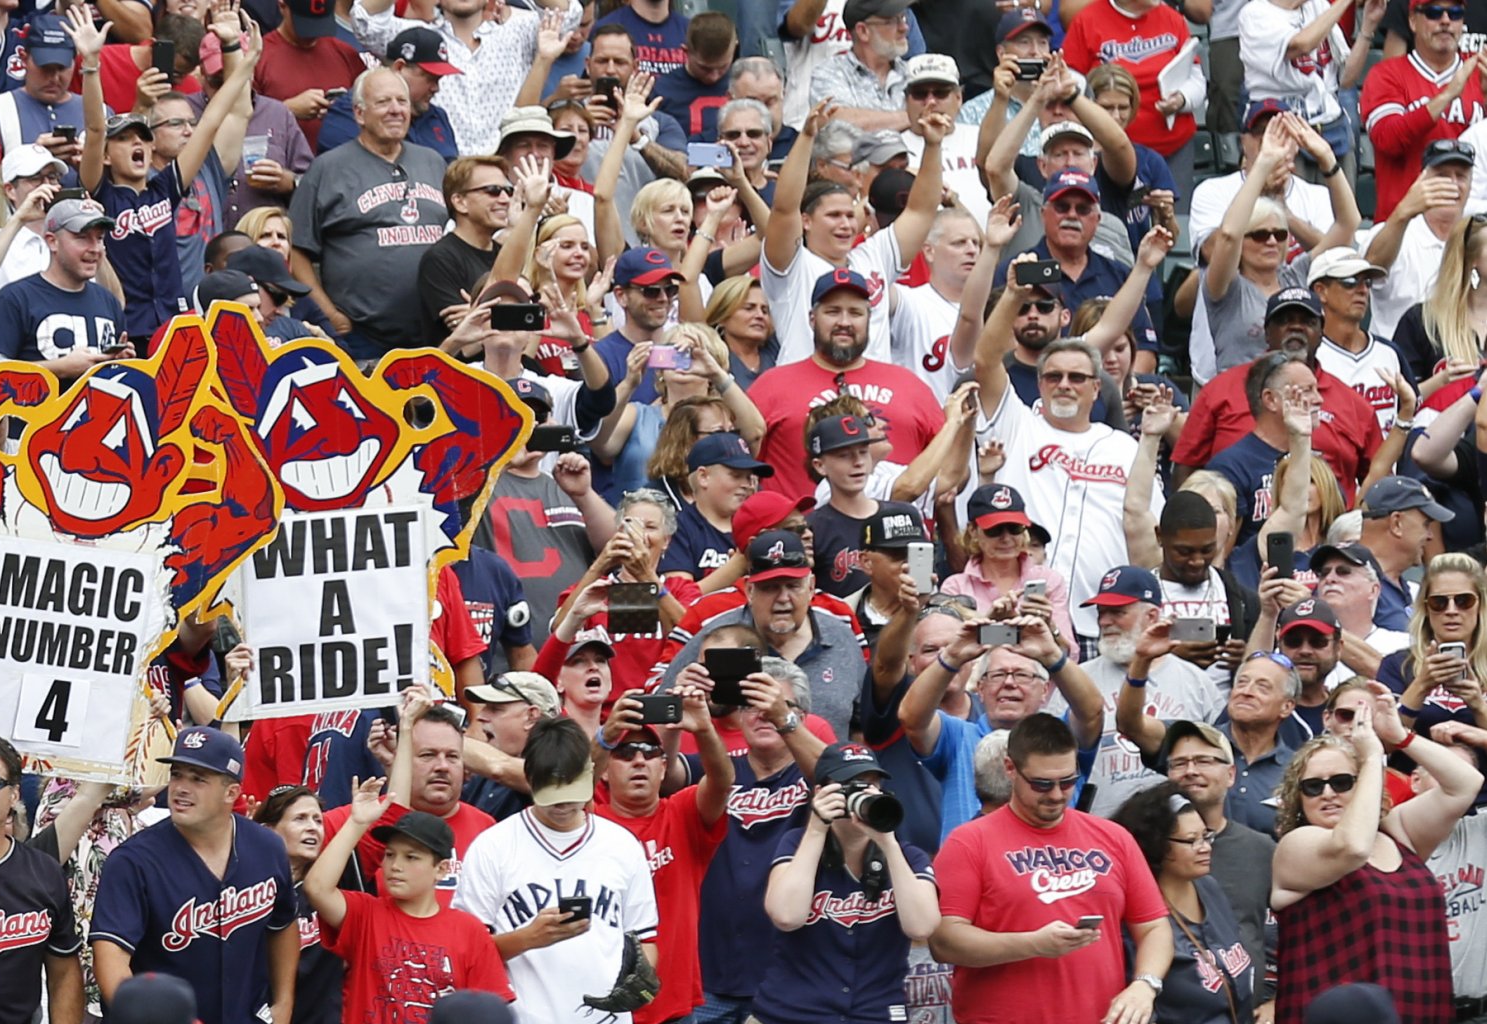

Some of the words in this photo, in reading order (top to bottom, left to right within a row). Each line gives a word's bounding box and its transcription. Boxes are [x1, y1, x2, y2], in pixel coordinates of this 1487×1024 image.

[1029, 443, 1127, 488] Indians
[252, 511, 418, 580] WHAT
[318, 579, 356, 637] A
[258, 623, 415, 705] RIDE!
[34, 679, 73, 743] 4
[725, 777, 810, 830] ndians
[1004, 844, 1114, 877] WAHOO
[162, 875, 280, 952] Indians
